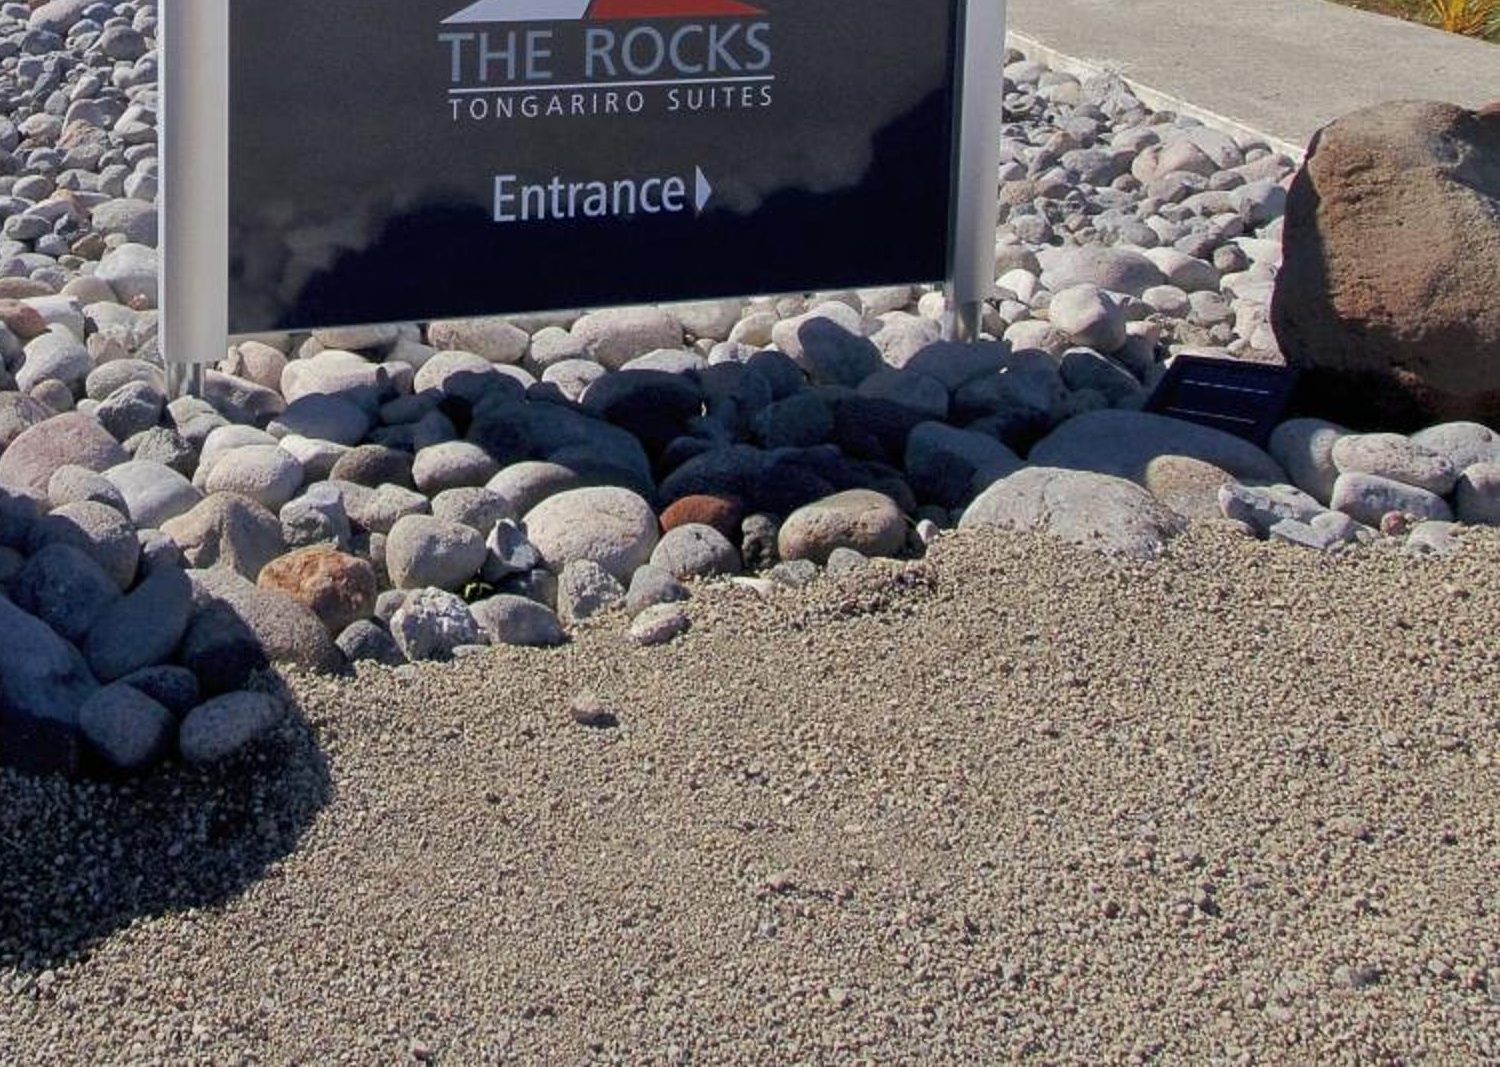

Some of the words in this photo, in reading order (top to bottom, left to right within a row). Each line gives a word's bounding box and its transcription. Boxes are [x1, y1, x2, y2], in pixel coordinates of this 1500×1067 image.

[438, 31, 553, 82] THE
[585, 22, 772, 78] ROCKS
[449, 91, 645, 121] TONGARIRO
[667, 85, 774, 111] SUITES
[493, 174, 685, 222] Entrance
